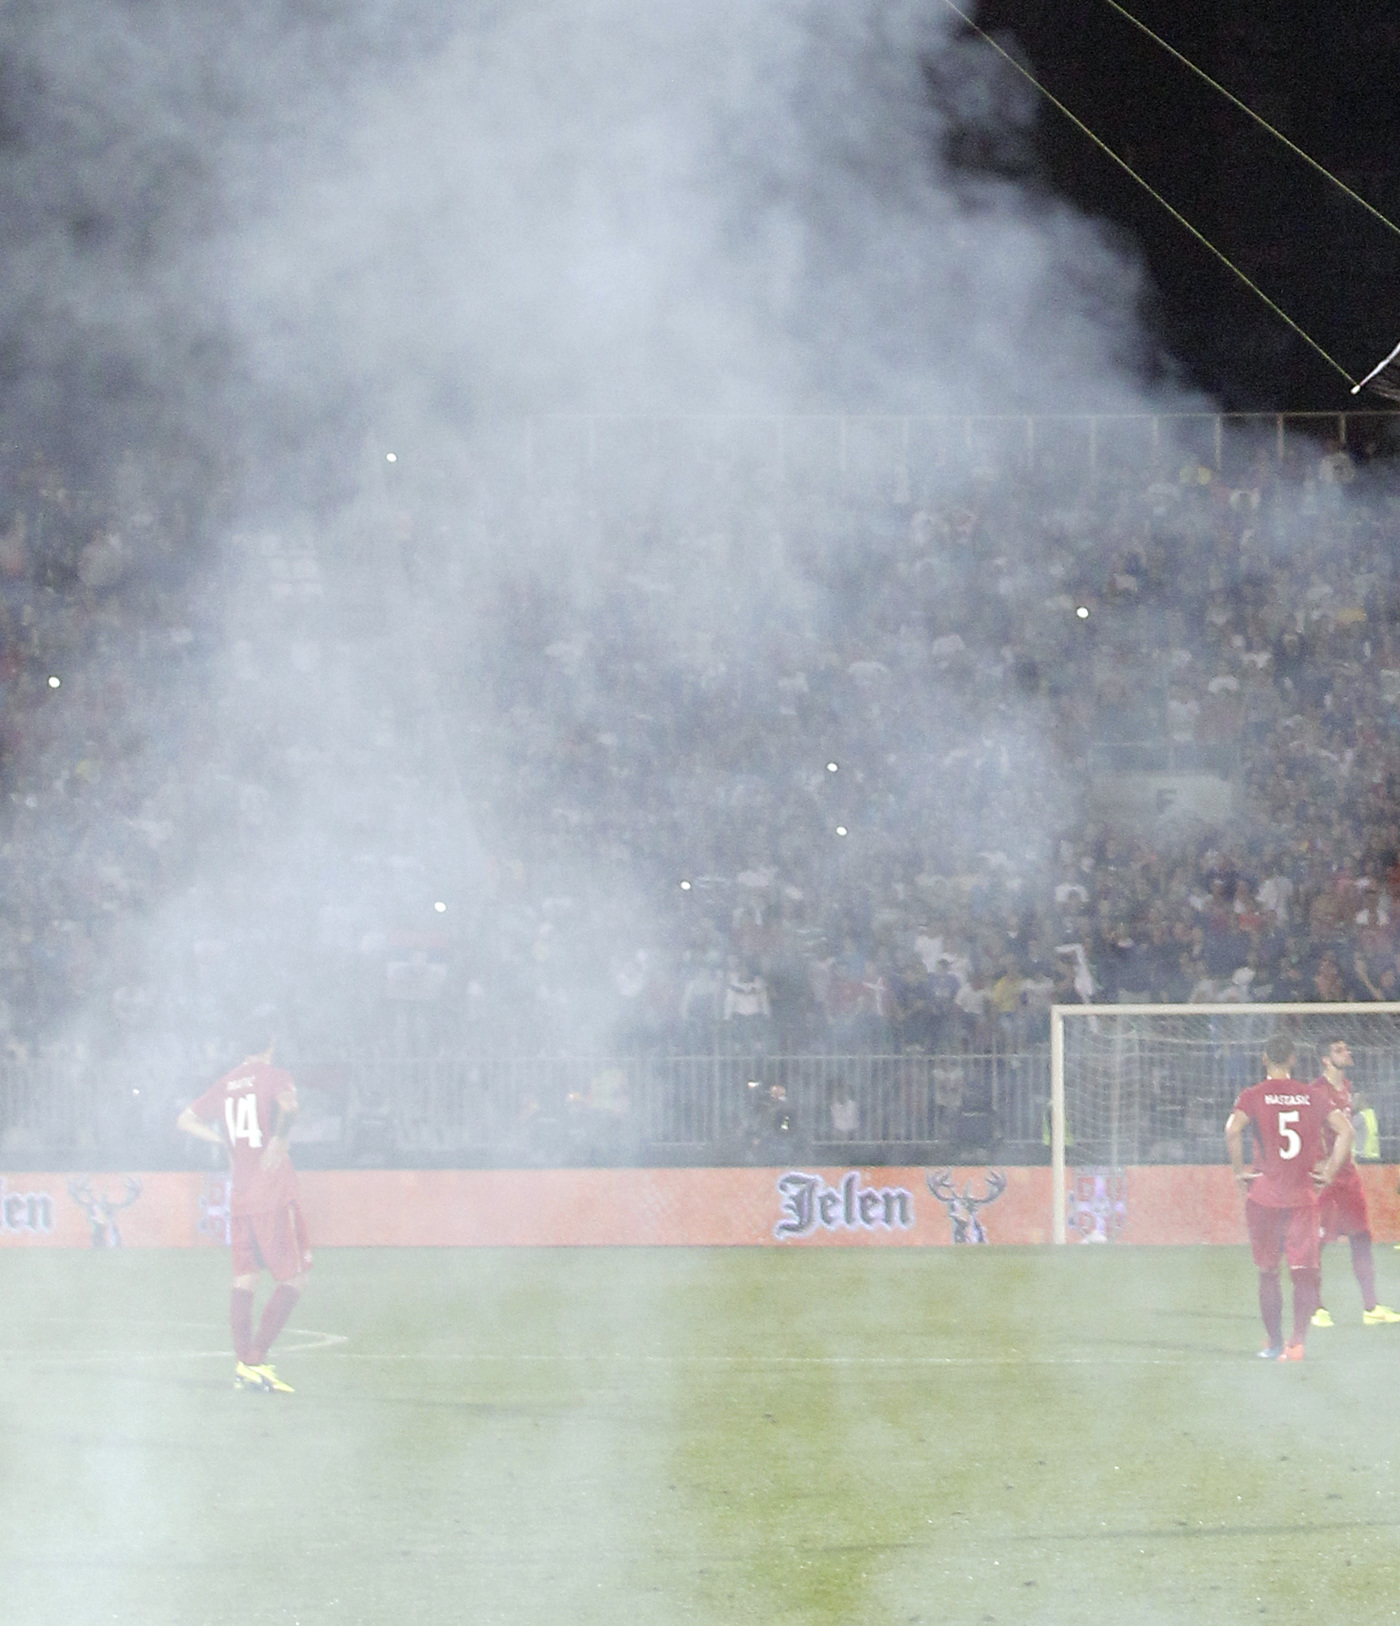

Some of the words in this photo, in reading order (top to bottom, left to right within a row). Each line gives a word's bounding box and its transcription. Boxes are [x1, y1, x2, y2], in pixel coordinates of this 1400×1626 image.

[224, 1093, 263, 1148] 14
[1278, 1110, 1302, 1160] 5
[0, 1176, 56, 1234] en
[774, 1171, 916, 1239] Jelen
